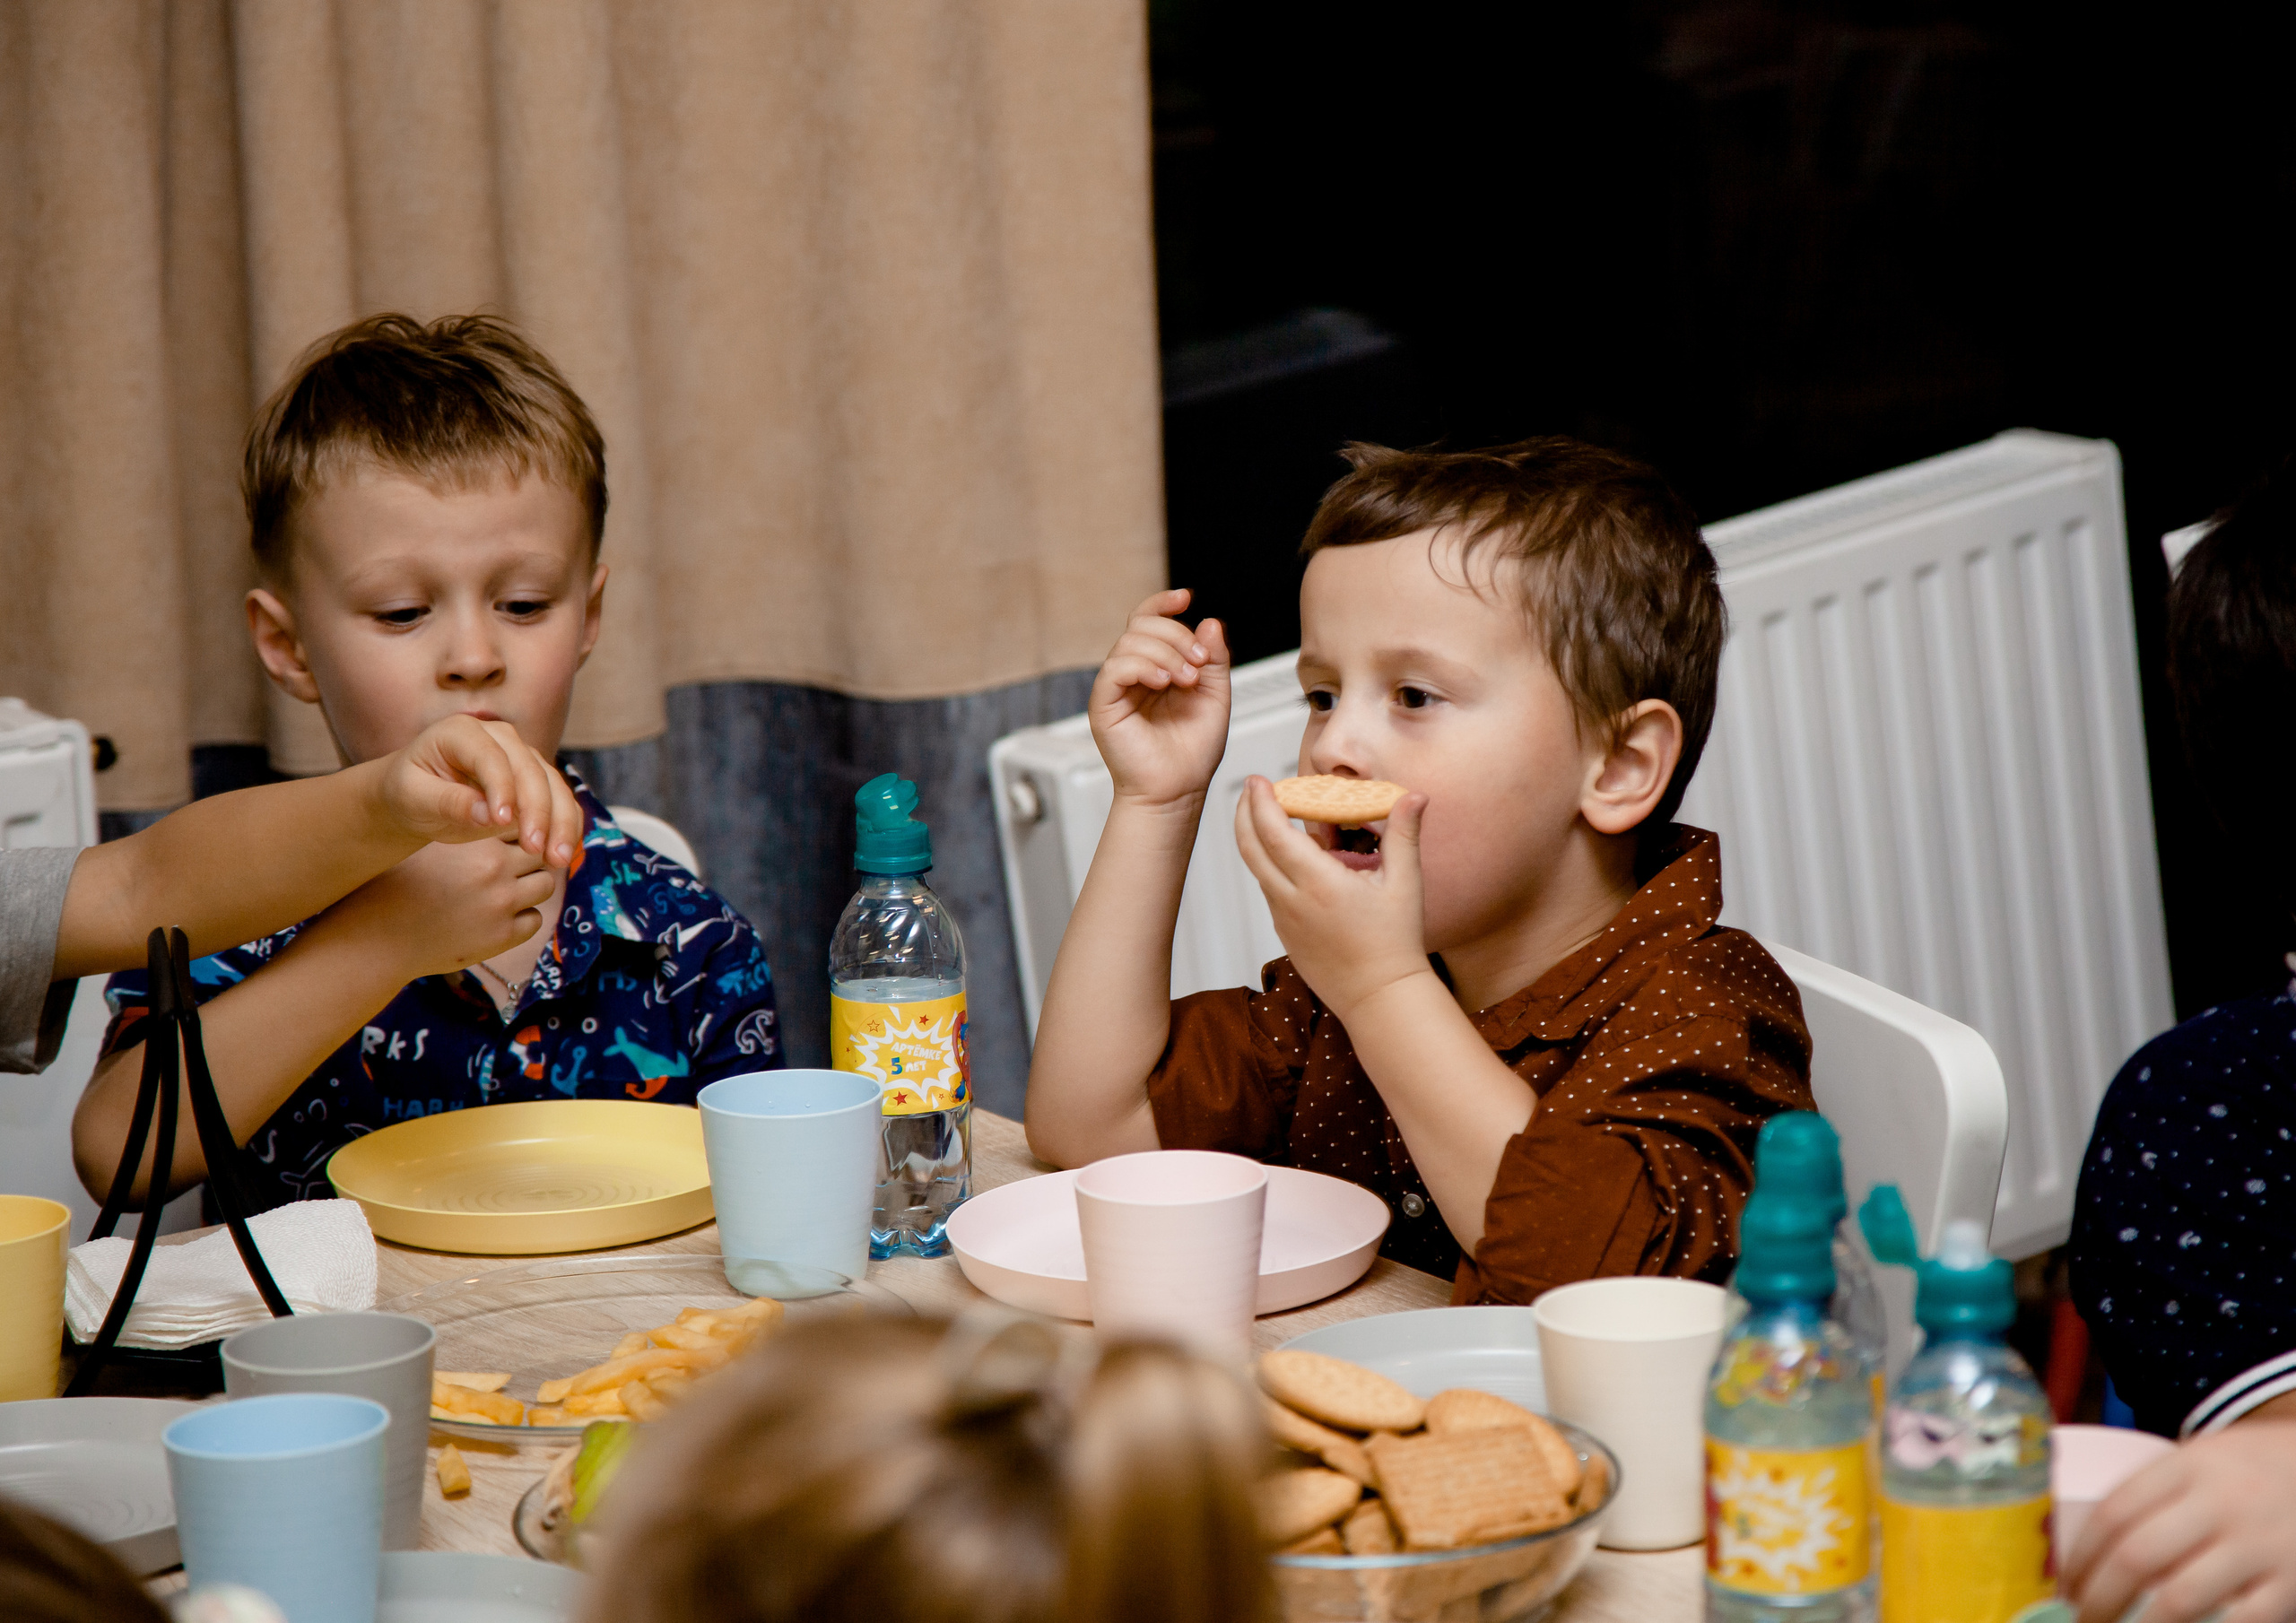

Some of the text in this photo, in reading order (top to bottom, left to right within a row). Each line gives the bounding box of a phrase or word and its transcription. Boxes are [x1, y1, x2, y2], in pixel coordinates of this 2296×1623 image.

[891, 1042, 942, 1061] АРТЁМКЕ
[891, 1056, 926, 1075] 5 ЛЕТ
